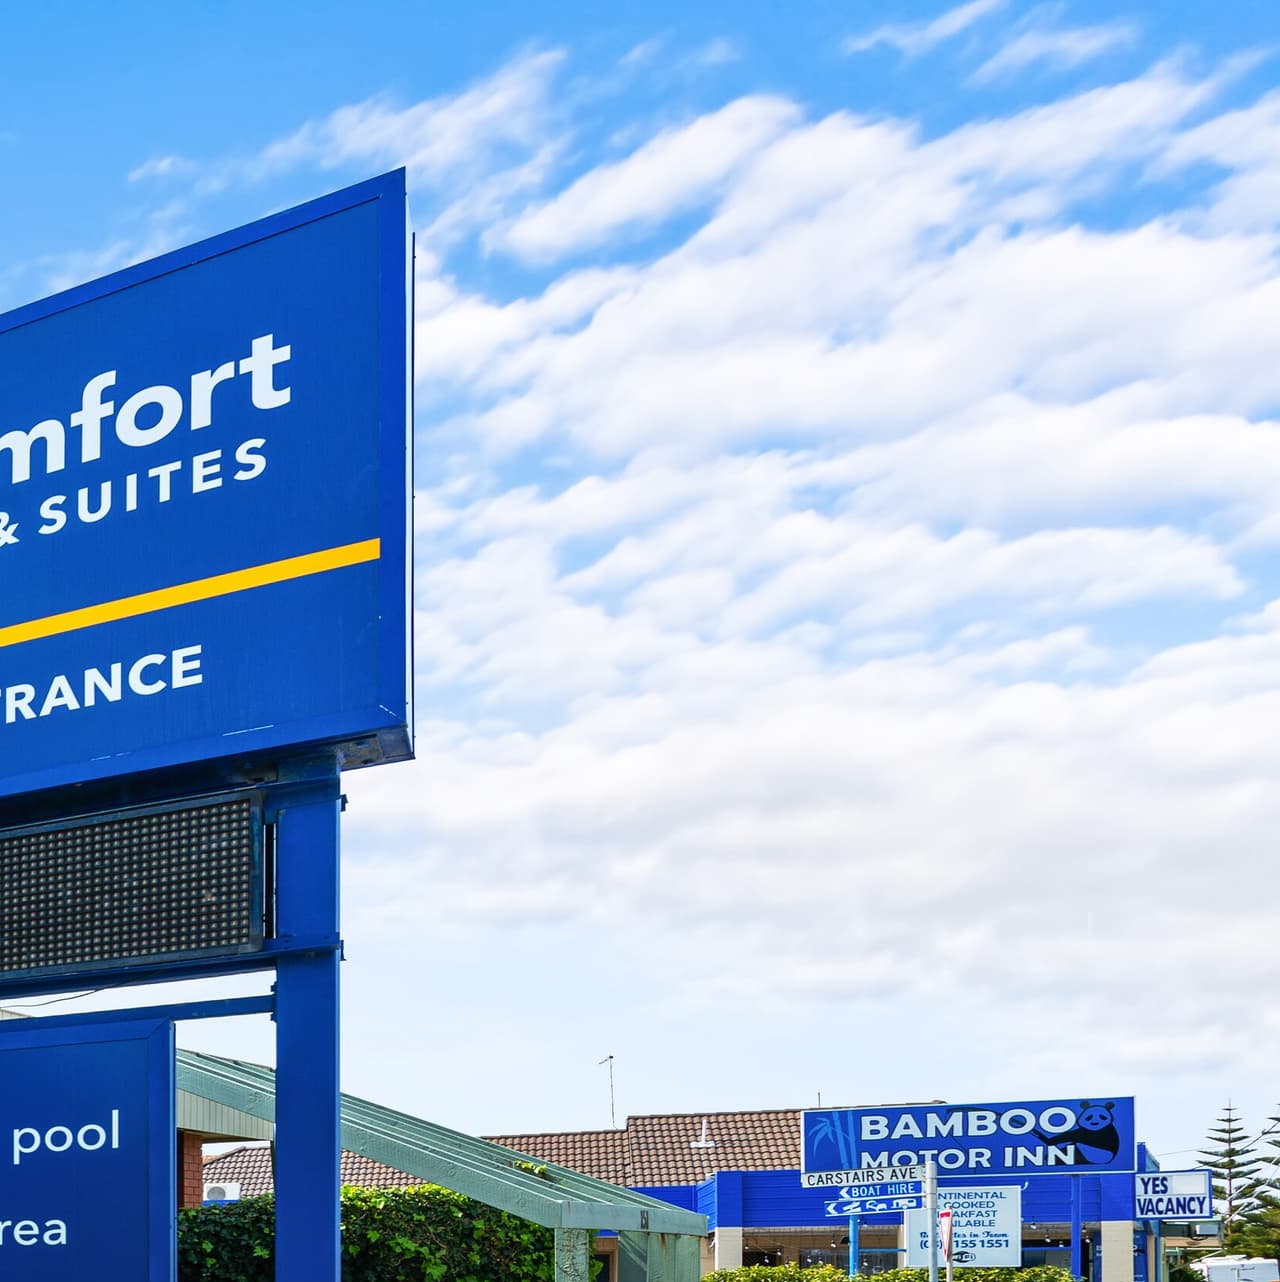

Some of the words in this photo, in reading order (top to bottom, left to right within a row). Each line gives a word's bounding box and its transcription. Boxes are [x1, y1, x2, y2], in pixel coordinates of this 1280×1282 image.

[38, 439, 266, 535] SUITES
[861, 1107, 1077, 1140] BAMBOO
[13, 1110, 119, 1165] pool
[861, 1148, 991, 1169] MOTOR
[1004, 1145, 1075, 1167] INN
[807, 1169, 885, 1186] CARSTAIRS
[889, 1167, 918, 1180] AVE
[1140, 1176, 1169, 1195] YES
[851, 1185, 881, 1197] BOAT
[887, 1182, 916, 1195] HIRE
[1137, 1196, 1206, 1216] VACANCY
[979, 1239, 1009, 1248] 1551
